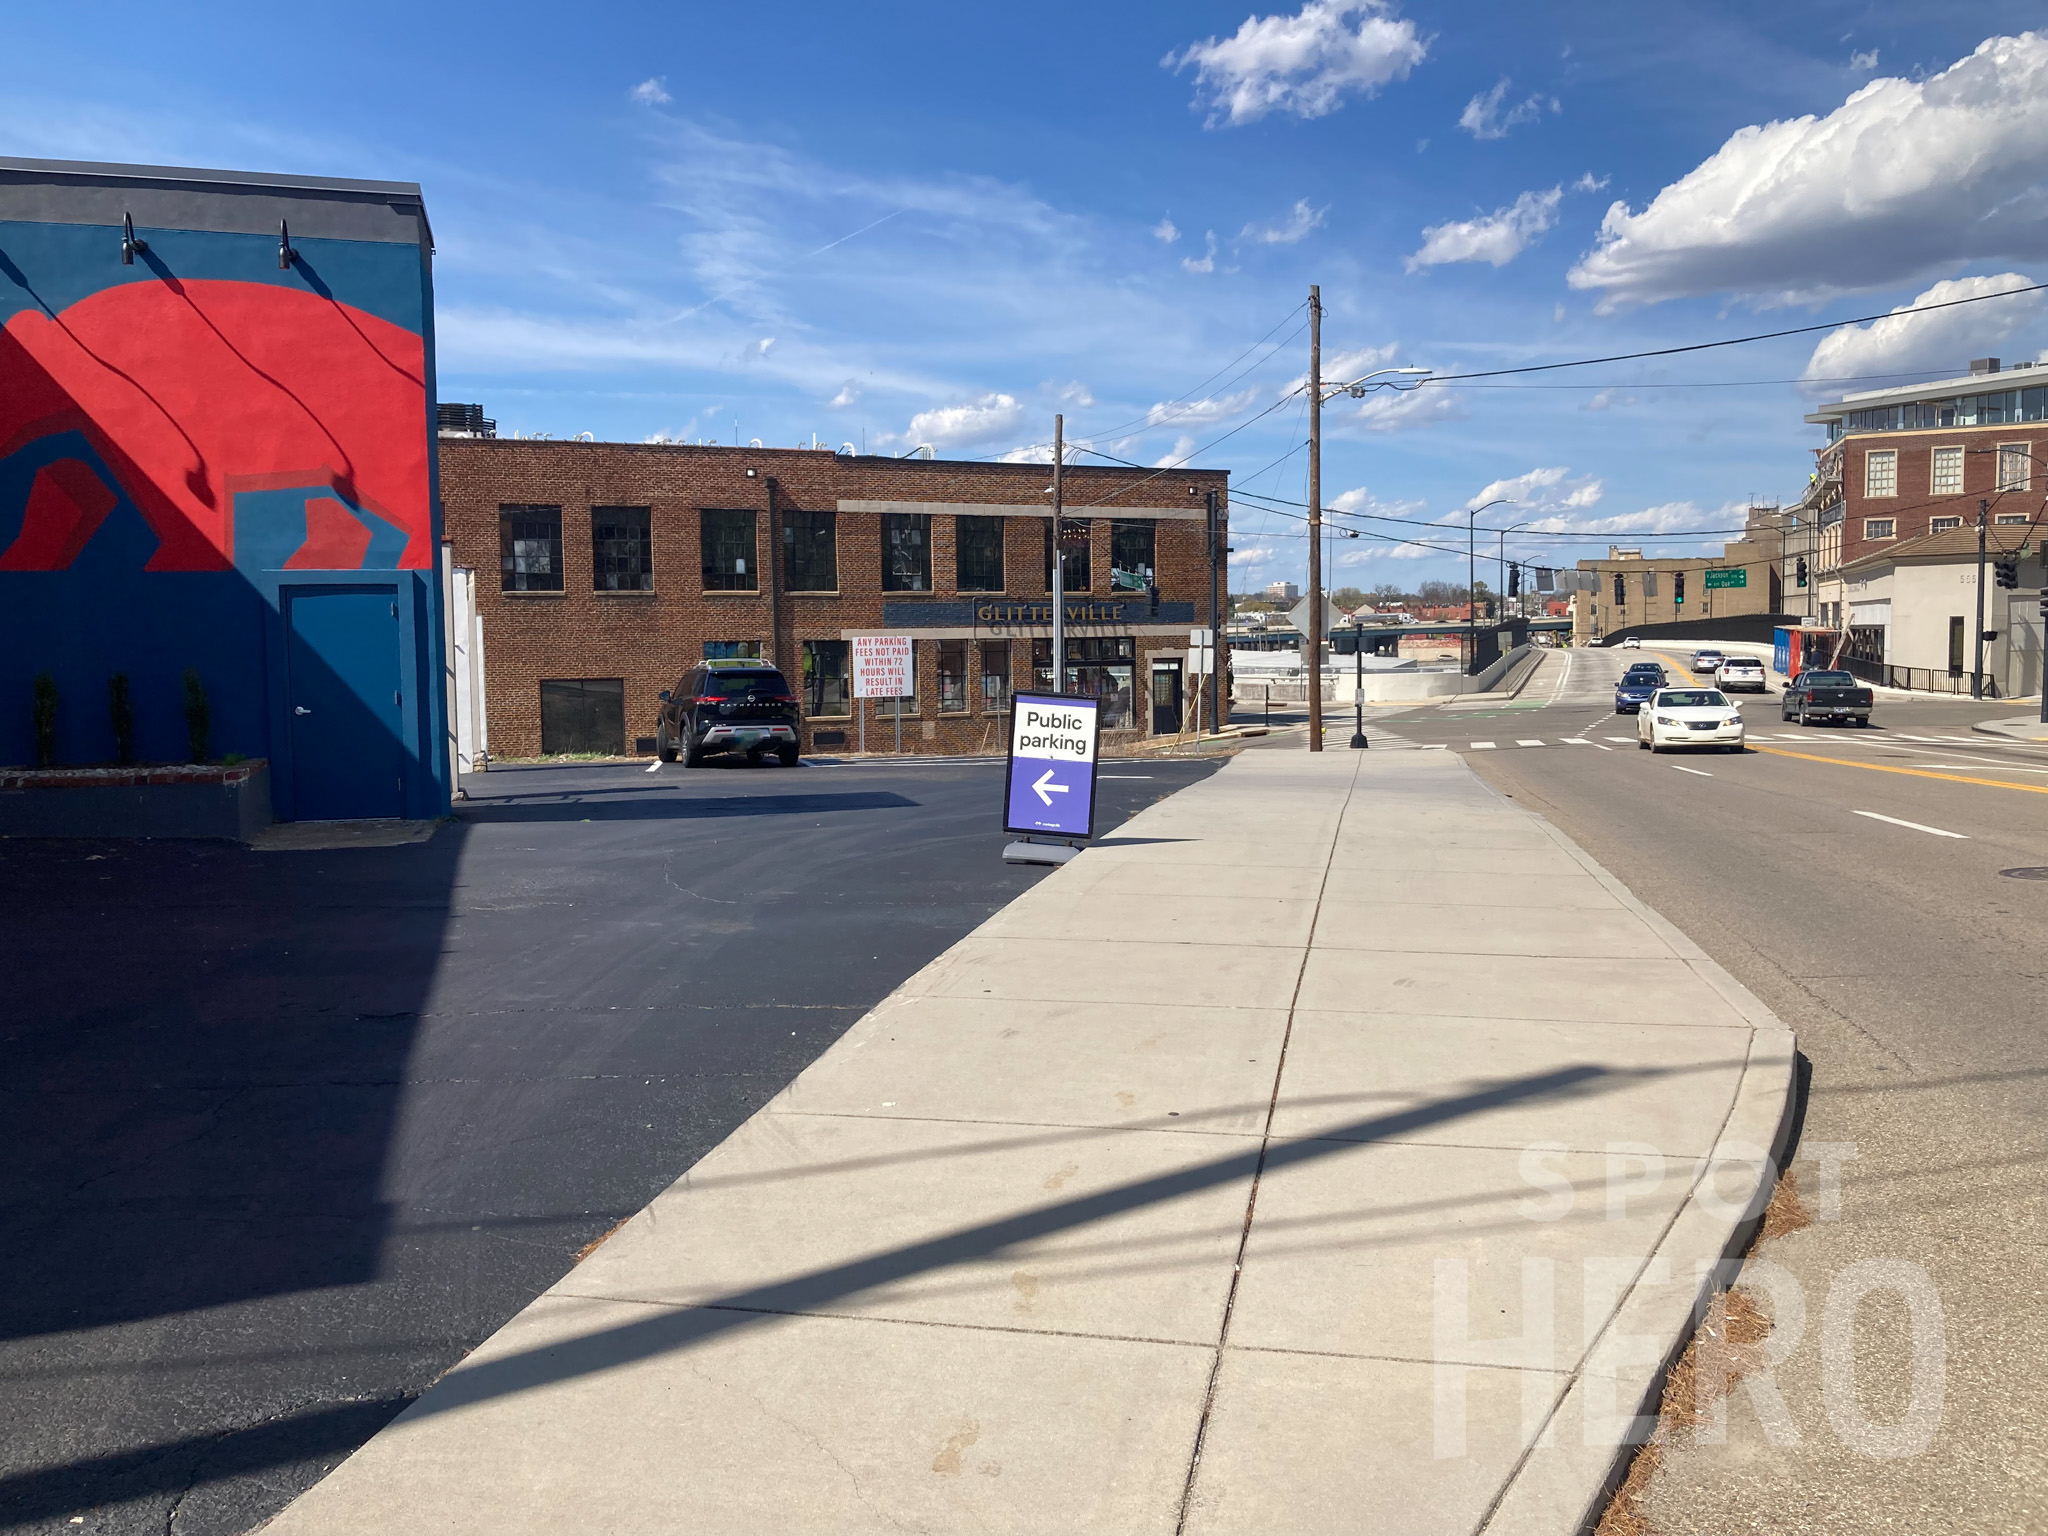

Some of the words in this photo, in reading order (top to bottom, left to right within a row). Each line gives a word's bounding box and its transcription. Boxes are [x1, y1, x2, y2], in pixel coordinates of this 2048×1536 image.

[1960, 575, 1976, 584] 555
[978, 606, 1121, 621] GLITTEVILLE
[857, 637, 872, 646] ANY
[874, 637, 907, 646] PARKING
[855, 647, 873, 656] FEES
[875, 647, 890, 656] NOT
[892, 647, 909, 656] PAID
[864, 658, 892, 666] WITHIN
[893, 657, 903, 665] 72
[860, 667, 885, 676] HOURS
[887, 667, 906, 675] WILL
[865, 677, 893, 686] RESULT
[894, 677, 903, 685] IN
[865, 687, 883, 696] LATE
[885, 686, 903, 695] FEES
[1027, 711, 1083, 730] Public
[1019, 733, 1087, 755] parking
